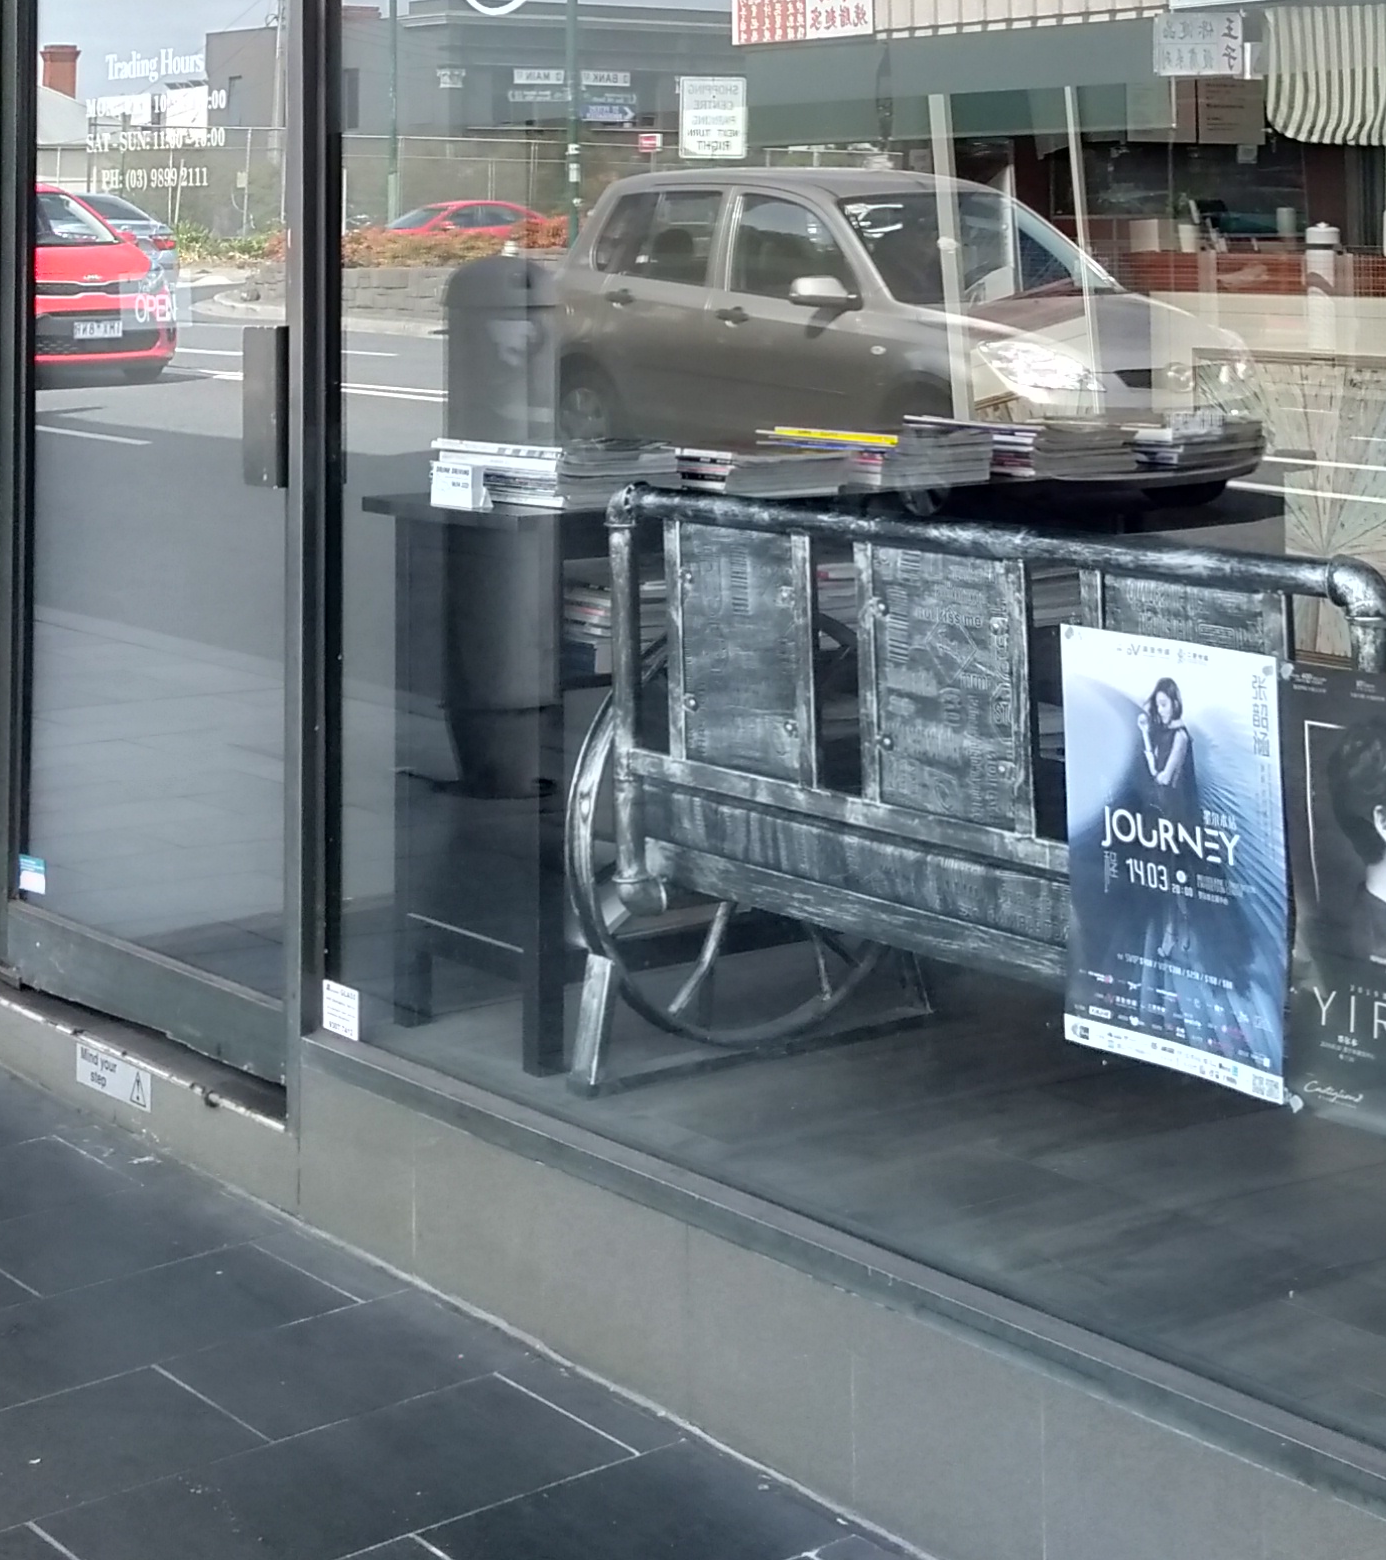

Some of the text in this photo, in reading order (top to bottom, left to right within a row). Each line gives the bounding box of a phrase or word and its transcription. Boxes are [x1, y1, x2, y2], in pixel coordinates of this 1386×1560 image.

[105, 48, 205, 83] Trading Hours
[101, 169, 123, 191] PH:
[126, 168, 148, 191] (03)
[135, 294, 177, 322] OPEN
[1101, 806, 1241, 867] JOURNEY
[1125, 858, 1169, 891] 14.03
[80, 1045, 118, 1074] Mind your
[90, 1070, 108, 1089] step
